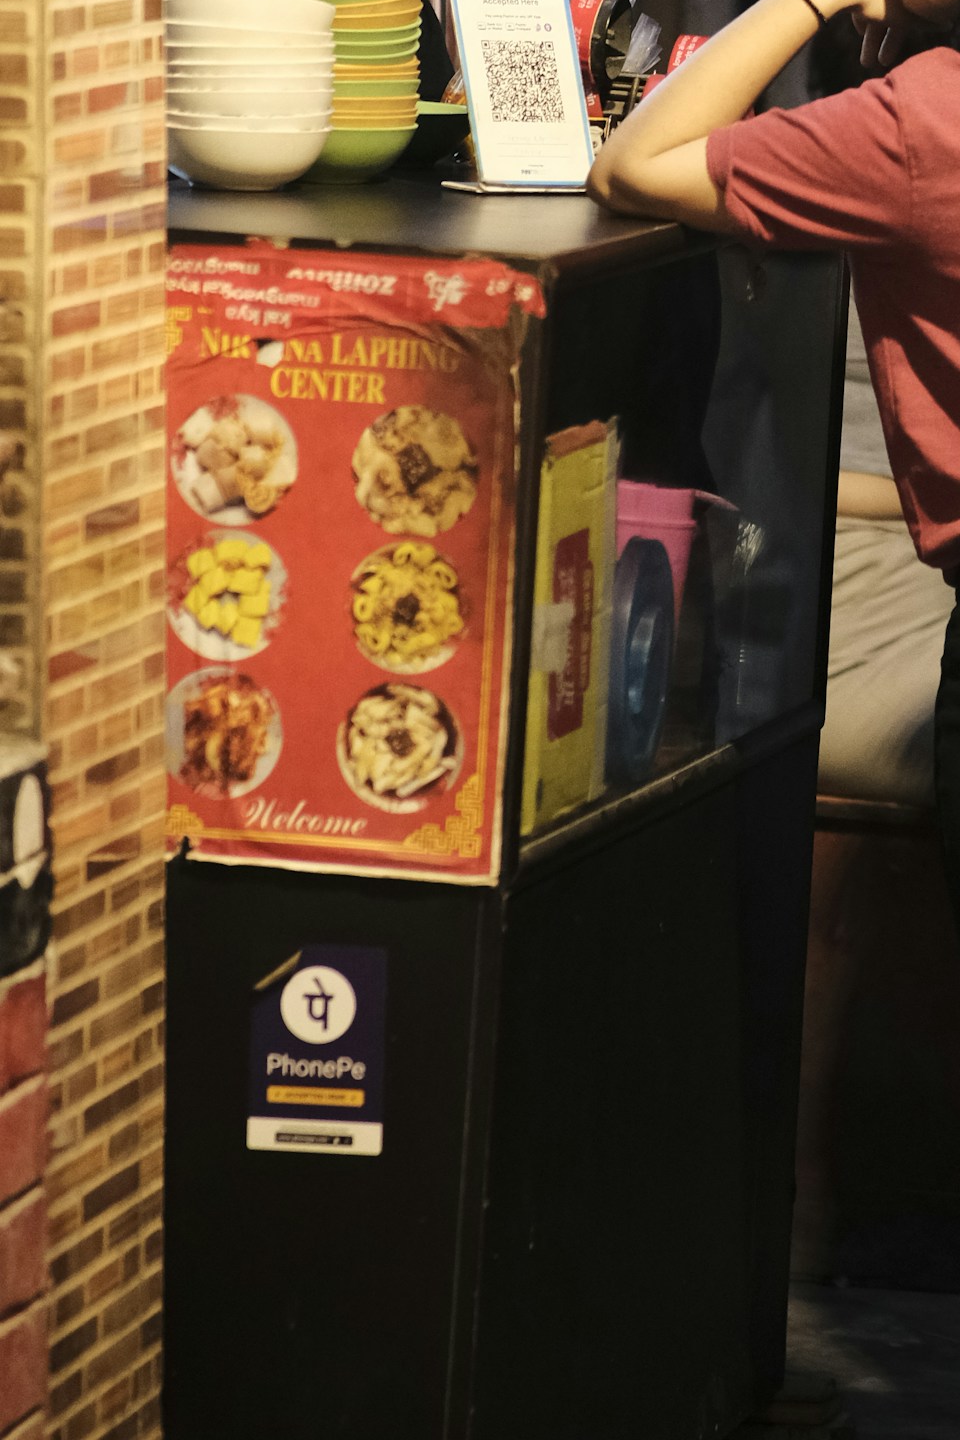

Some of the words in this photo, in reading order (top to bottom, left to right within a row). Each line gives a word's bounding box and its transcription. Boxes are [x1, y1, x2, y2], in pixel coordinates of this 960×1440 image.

[332, 334, 460, 372] LAPHING
[271, 368, 386, 404] CENTER
[242, 795, 369, 836] Welcome
[266, 1052, 366, 1081] PhonePe
